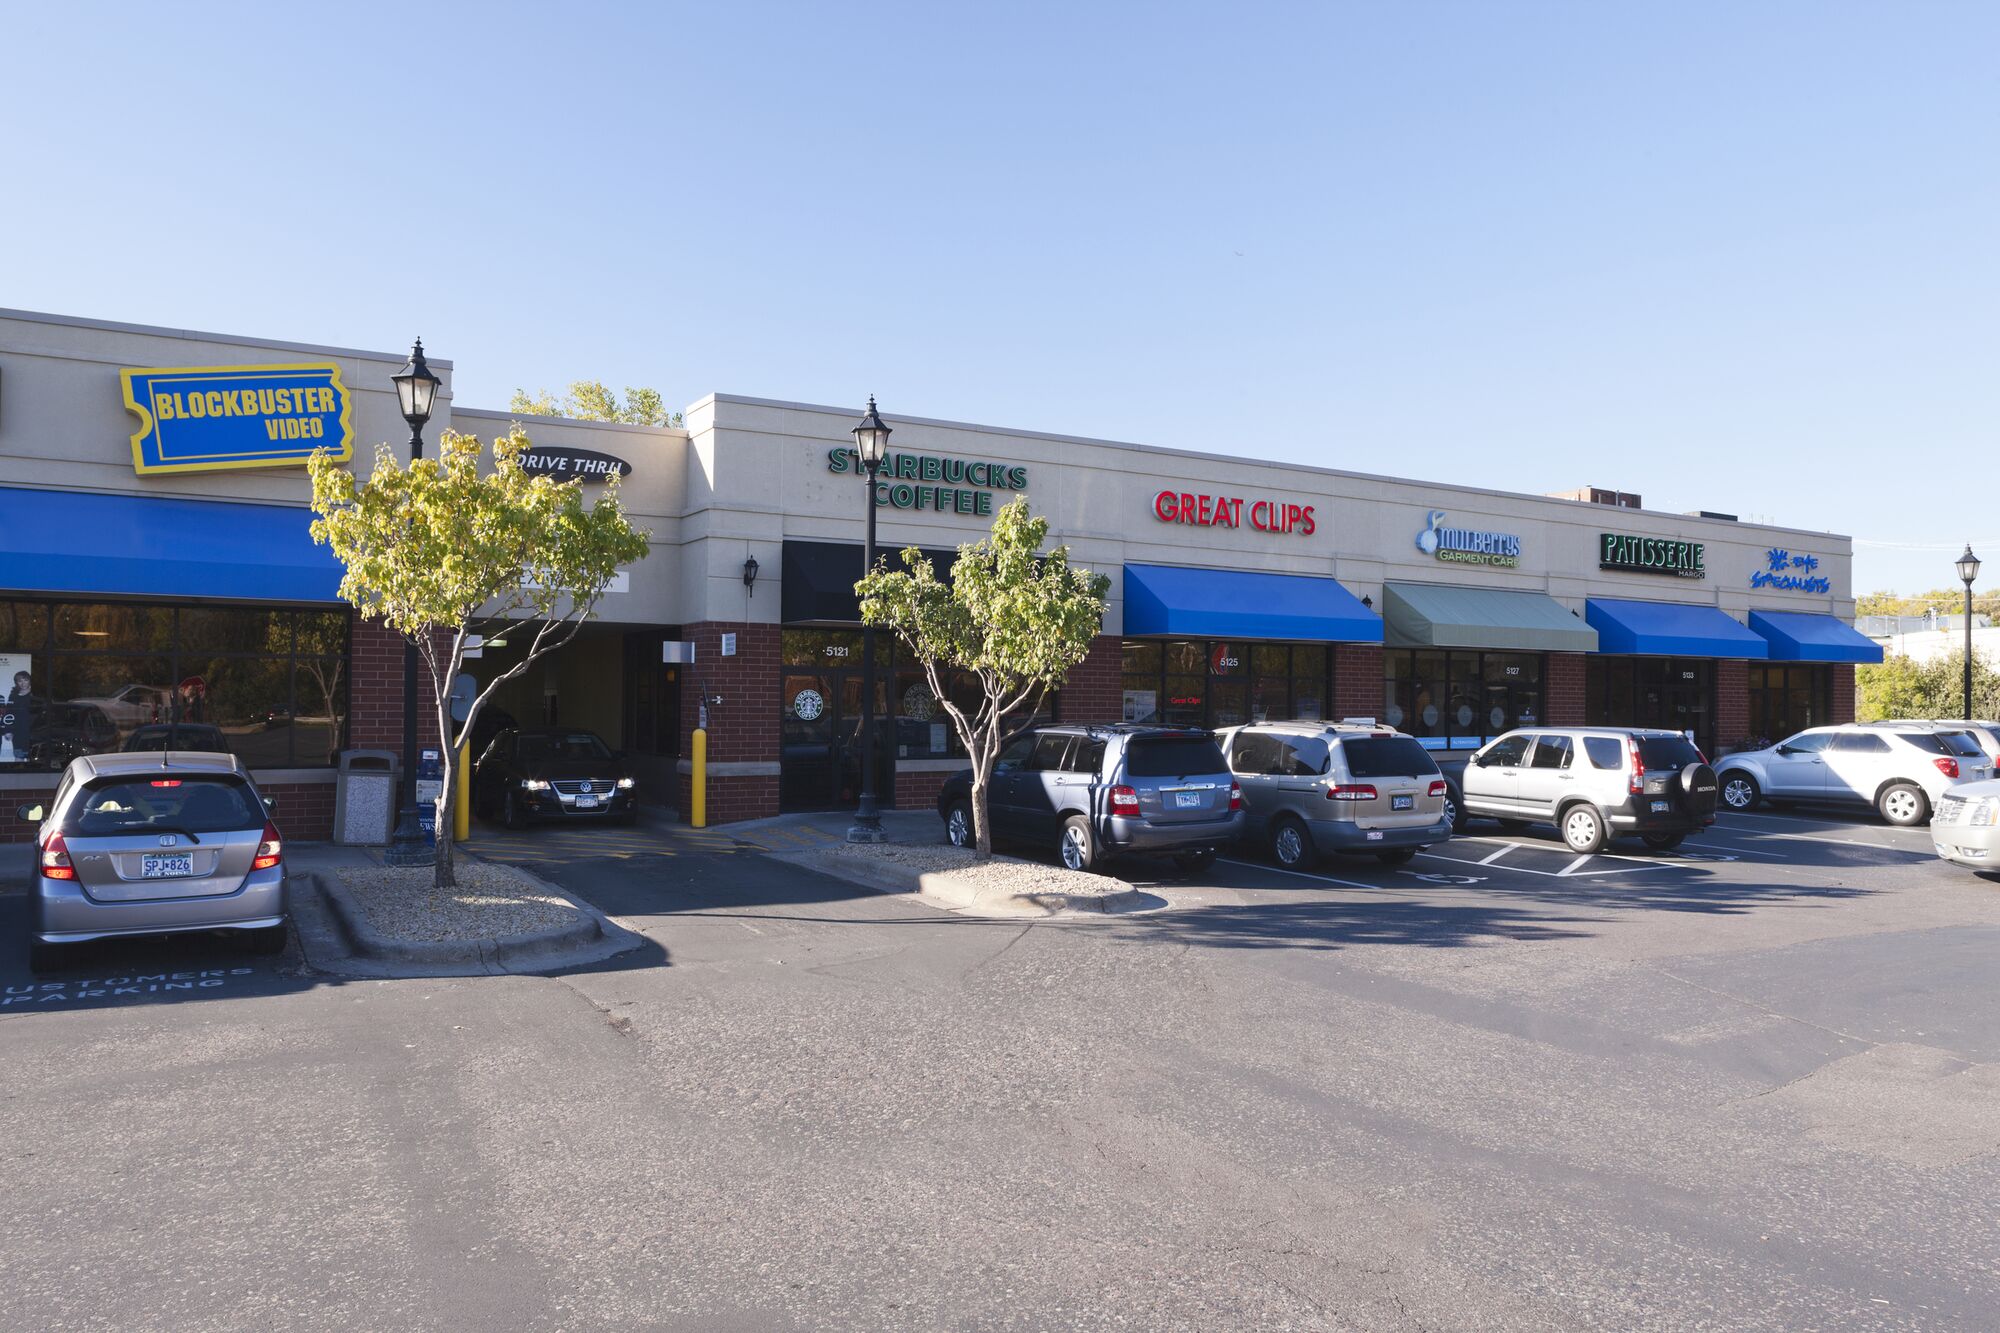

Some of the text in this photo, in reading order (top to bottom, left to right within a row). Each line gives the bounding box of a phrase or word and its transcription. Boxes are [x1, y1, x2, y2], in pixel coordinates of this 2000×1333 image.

[155, 387, 336, 420] BLOCKBUSTER
[265, 417, 324, 440] VIDEO
[516, 454, 568, 471] DRIVE
[829, 447, 1028, 491] STARBUCKS
[875, 481, 993, 516] COFFEE
[1153, 490, 1316, 535] GREAT CLIPS
[1440, 550, 1520, 568] GARMENT CARE
[1601, 533, 1705, 570] PATISSERIE
[1678, 570, 1704, 579] MARGO
[826, 646, 849, 657] 5121
[1220, 658, 1239, 667] 5125
[1506, 667, 1520, 675] 5127
[1, 979, 225, 1004] PARKING
